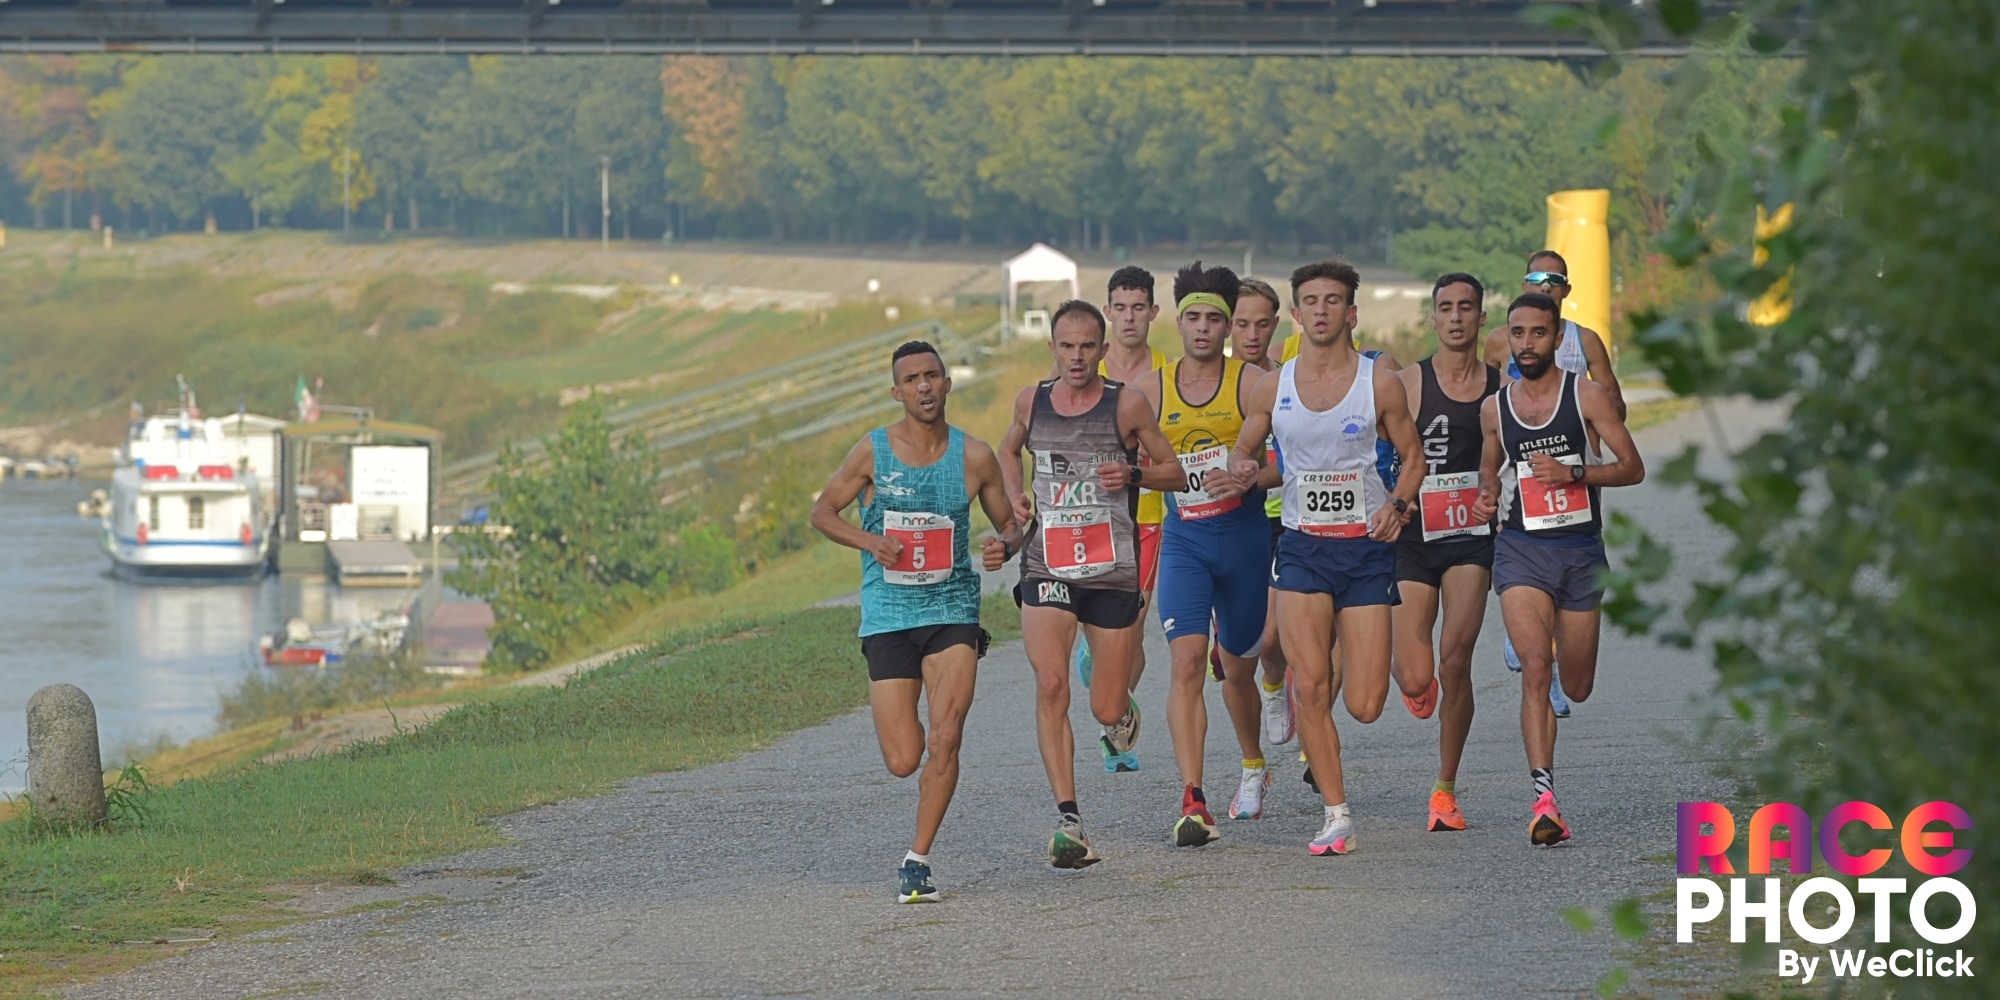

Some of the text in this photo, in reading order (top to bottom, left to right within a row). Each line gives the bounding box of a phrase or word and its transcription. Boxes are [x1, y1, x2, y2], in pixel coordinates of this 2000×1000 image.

[1519, 434, 1567, 451] ATLETICA
[1177, 449, 1221, 465] R10RUN
[1054, 461, 1089, 476] EA7
[1303, 472, 1357, 482] CR10RUN
[1437, 475, 1468, 487] hmc
[1049, 480, 1099, 507] DKR
[1306, 490, 1355, 512] 3259
[1544, 488, 1568, 513] 15
[1061, 511, 1093, 522] hmc
[1200, 507, 1222, 517] 10km
[1445, 504, 1468, 527] 10
[902, 516, 936, 526] hmc
[912, 546, 926, 570] 5
[1073, 542, 1087, 564] 8
[1038, 581, 1069, 599] DKR
